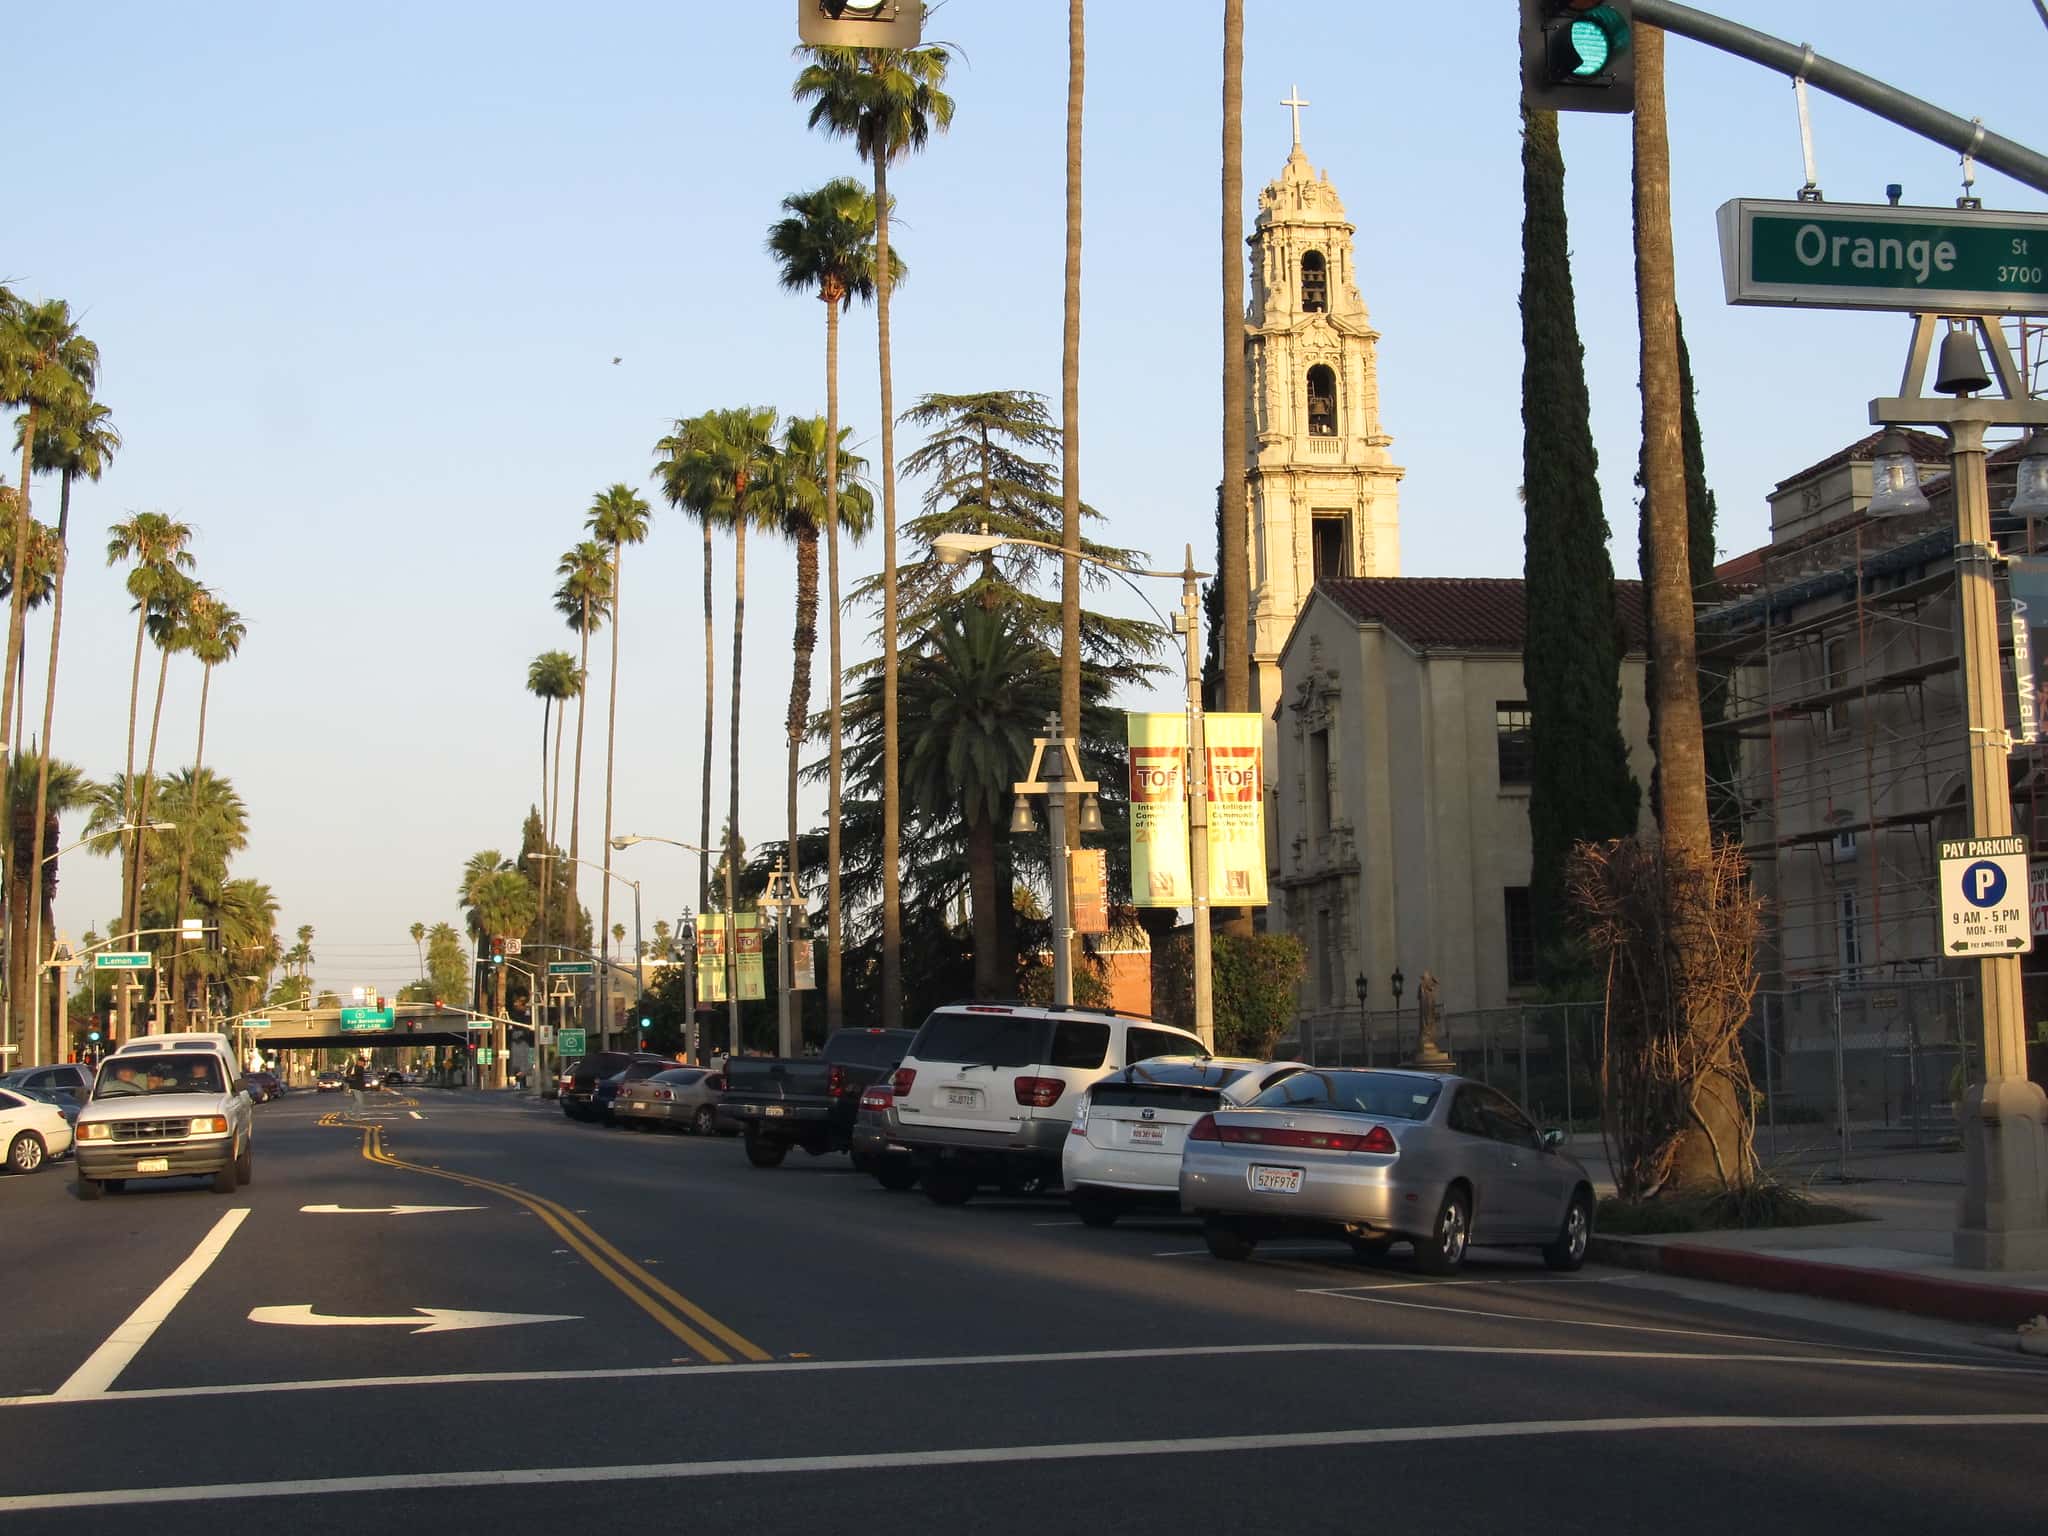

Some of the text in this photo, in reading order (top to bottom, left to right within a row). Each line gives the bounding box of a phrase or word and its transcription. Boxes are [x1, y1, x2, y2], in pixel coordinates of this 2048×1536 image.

[1795, 224, 1957, 284] Orange
[2011, 238, 2028, 256] St
[1997, 266, 2043, 284] 3700
[2011, 598, 2040, 743] Arts Walk
[1215, 769, 1254, 787] TOP
[1943, 838, 2024, 858] PAY PARKING
[1975, 868, 1996, 900] P
[1952, 912, 1960, 925] 9
[1963, 911, 1981, 924] AM
[1992, 910, 1999, 922] 5
[2002, 909, 2020, 922] PM
[1966, 925, 1986, 936] MON
[1994, 924, 2008, 934] FRI
[105, 957, 132, 965] Lemon
